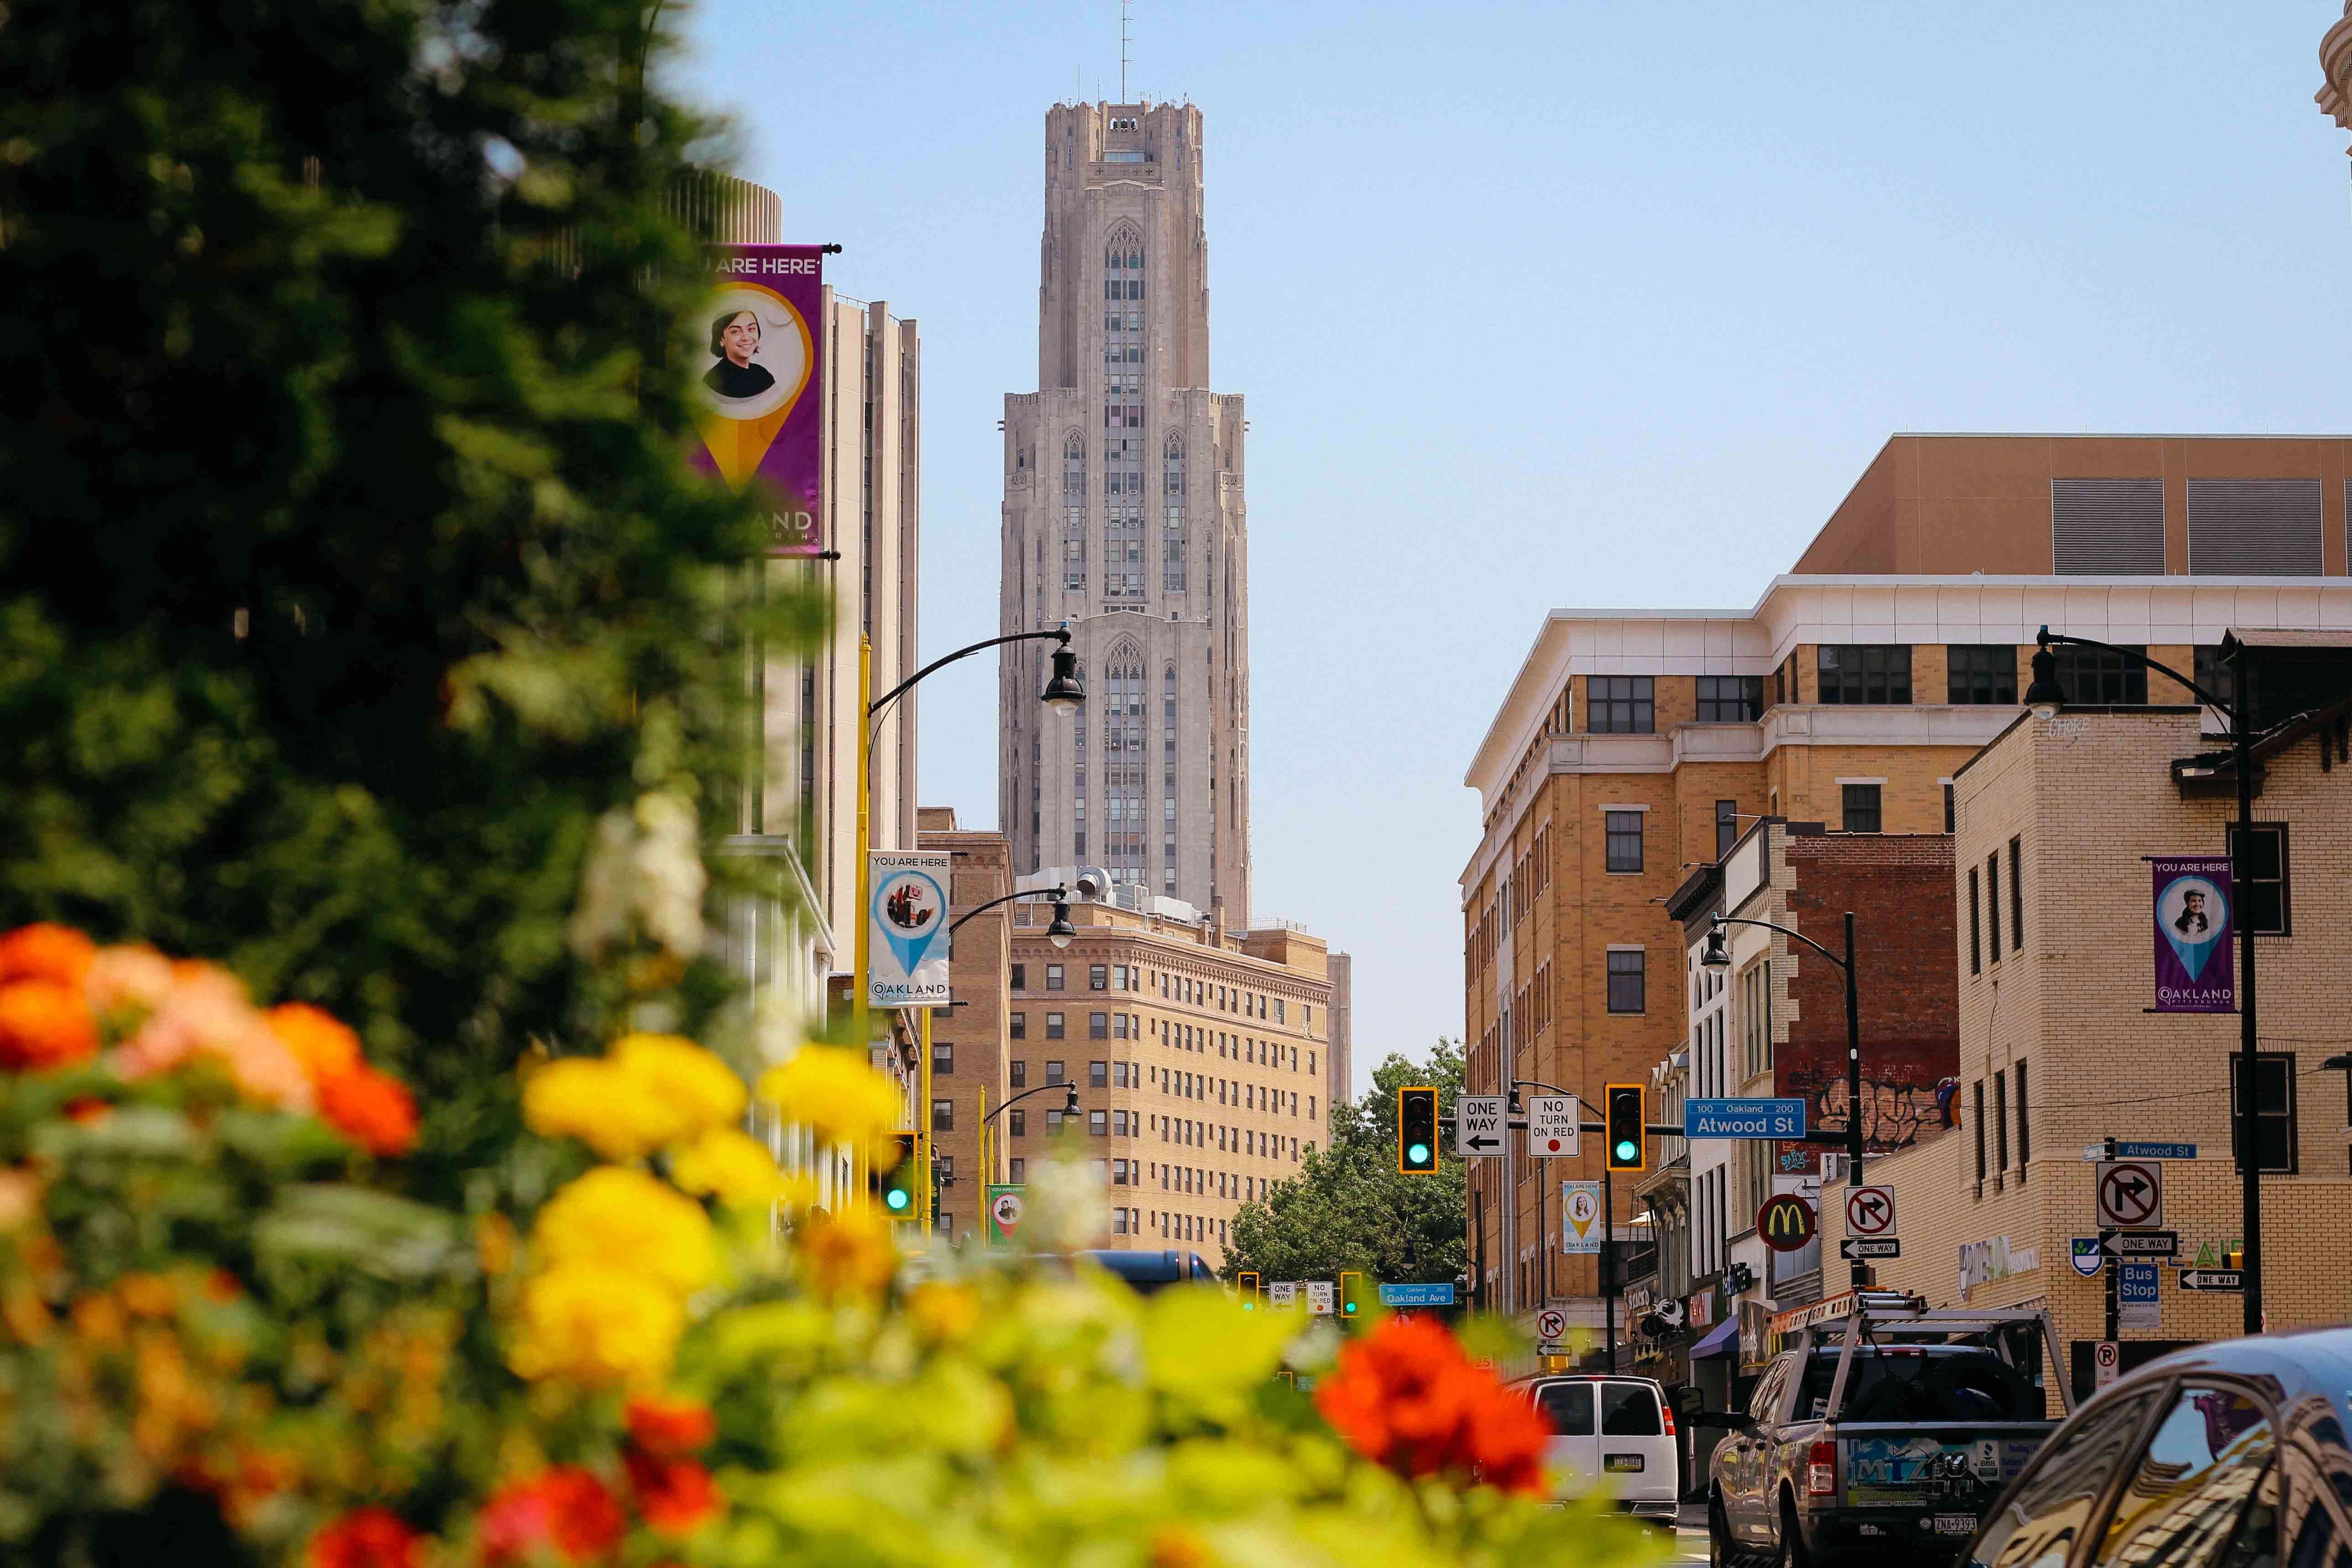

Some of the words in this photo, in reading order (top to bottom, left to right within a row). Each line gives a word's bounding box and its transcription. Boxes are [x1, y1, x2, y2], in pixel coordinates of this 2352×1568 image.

[762, 258, 816, 274] HERE
[921, 859, 948, 867] HERE
[872, 982, 945, 995] OAKLAND
[2158, 987, 2231, 999] OAKLAND
[1467, 1102, 1497, 1115] ONE
[1544, 1101, 1563, 1112] NO
[1466, 1118, 1497, 1131] WAY
[1540, 1115, 1568, 1124] TURN
[1697, 1118, 1767, 1132] Atwood
[1775, 1118, 1793, 1132] St
[1534, 1128, 1547, 1137] ON
[1554, 1128, 1574, 1137] RED
[2127, 1145, 2171, 1156] Atwood
[2177, 1146, 2189, 1156] St
[2123, 1239, 2145, 1249] ONE
[2148, 1239, 2169, 1249] WAY
[2125, 1268, 2152, 1280] Bus
[2197, 1276, 2213, 1284] ONE
[2123, 1284, 2156, 1298] Stop
[1387, 1294, 1425, 1303] Oakland
